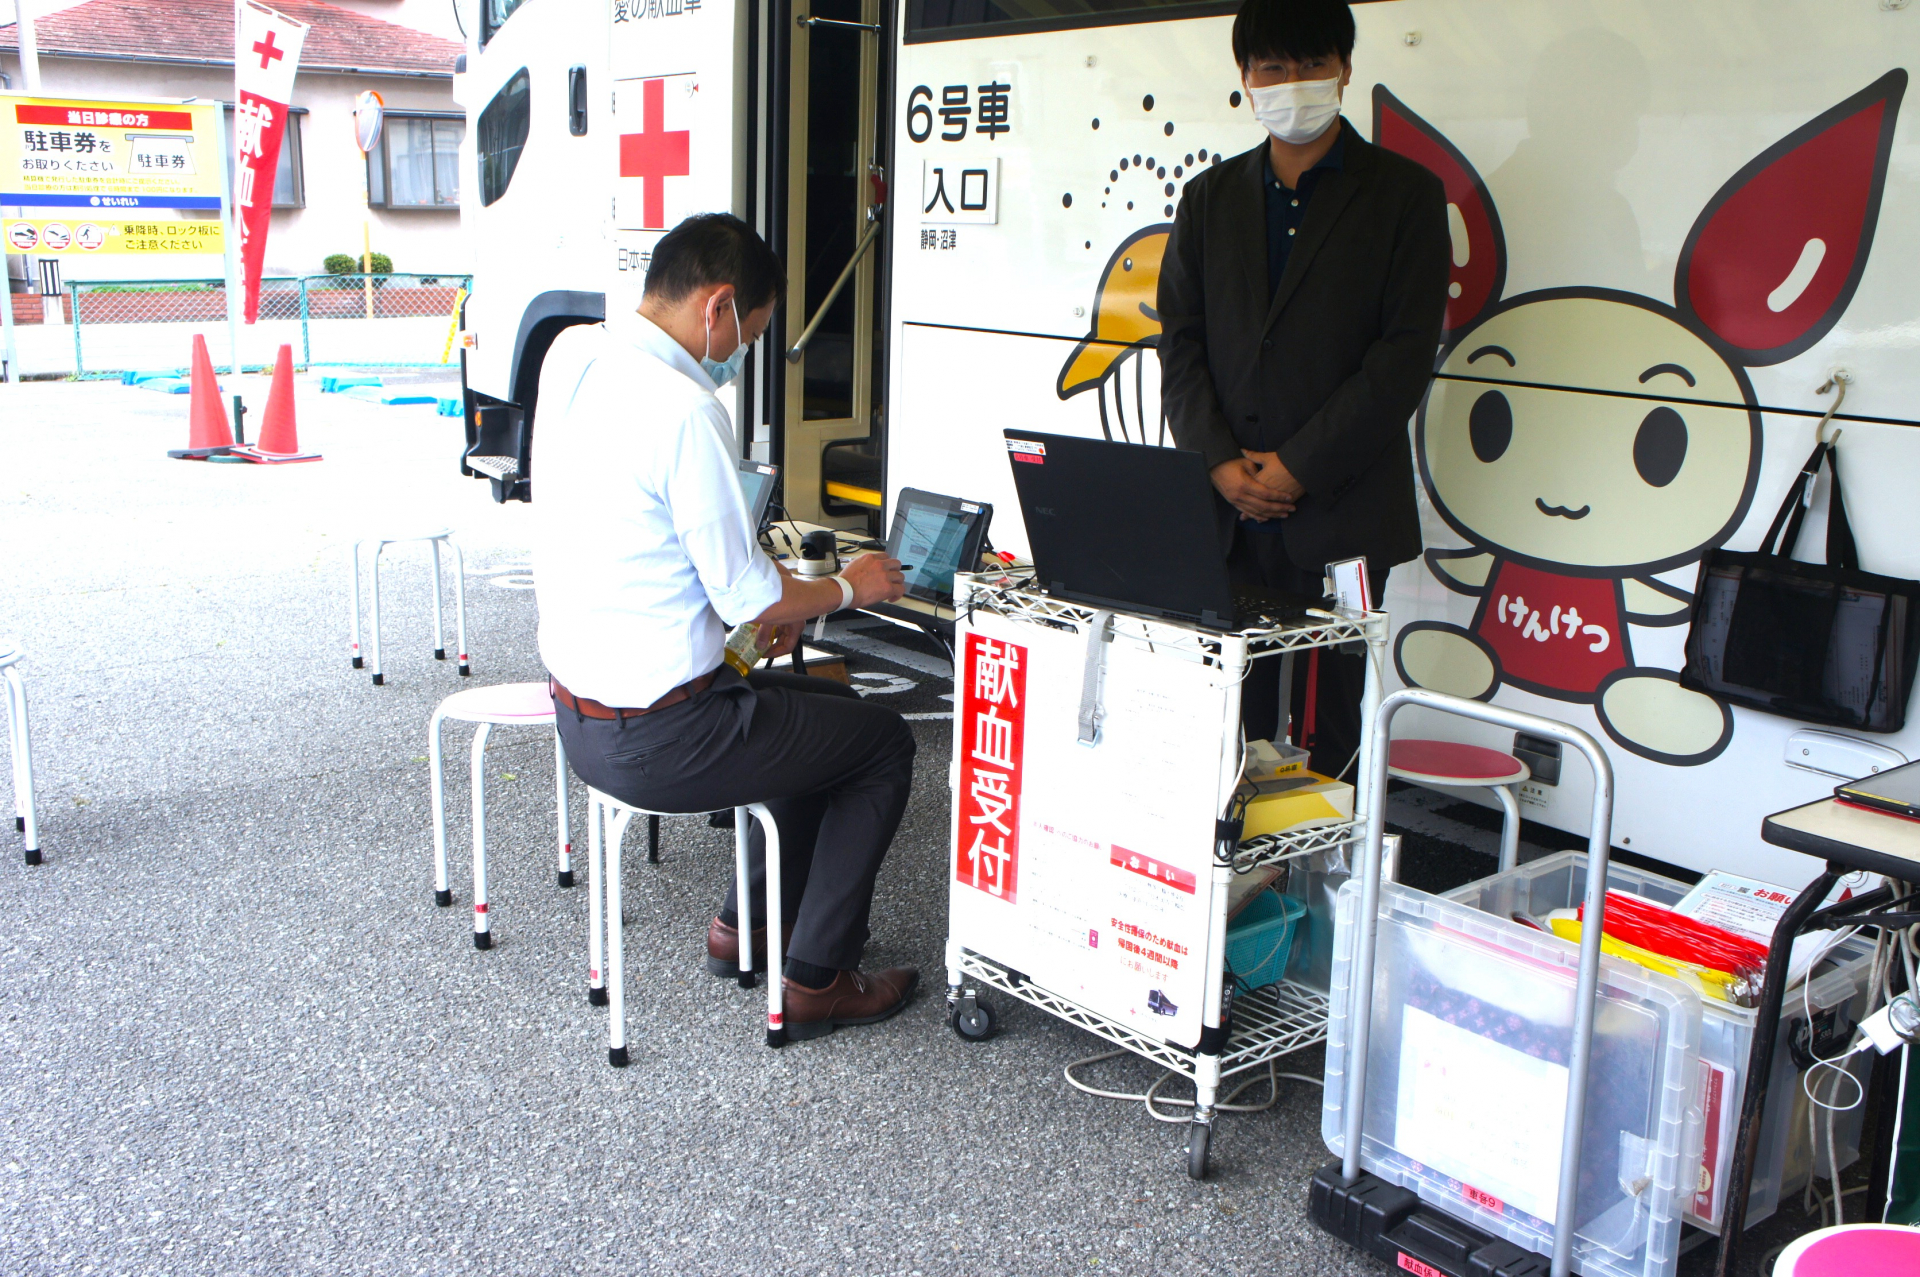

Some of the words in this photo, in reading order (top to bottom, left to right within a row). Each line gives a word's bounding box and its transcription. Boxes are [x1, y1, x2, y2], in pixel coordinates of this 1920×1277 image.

[68, 110, 149, 127] 当日診療の方
[906, 80, 1012, 144] 6号車
[24, 130, 111, 153] 駐車券を
[137, 153, 186, 169] 駐車券
[101, 196, 139, 207] せいれい
[924, 167, 989, 215] 入口
[124, 224, 220, 236] 乗降時、ロック板に
[125, 239, 203, 250] ご注意ください
[1035, 506, 1056, 516] NEC
[1497, 594, 1611, 653] けんけつ
[967, 638, 1019, 897] 献血受付
[1110, 917, 1189, 956] 安全性確保のため献血は
[1117, 937, 1180, 971] 帰国後4週間以降
